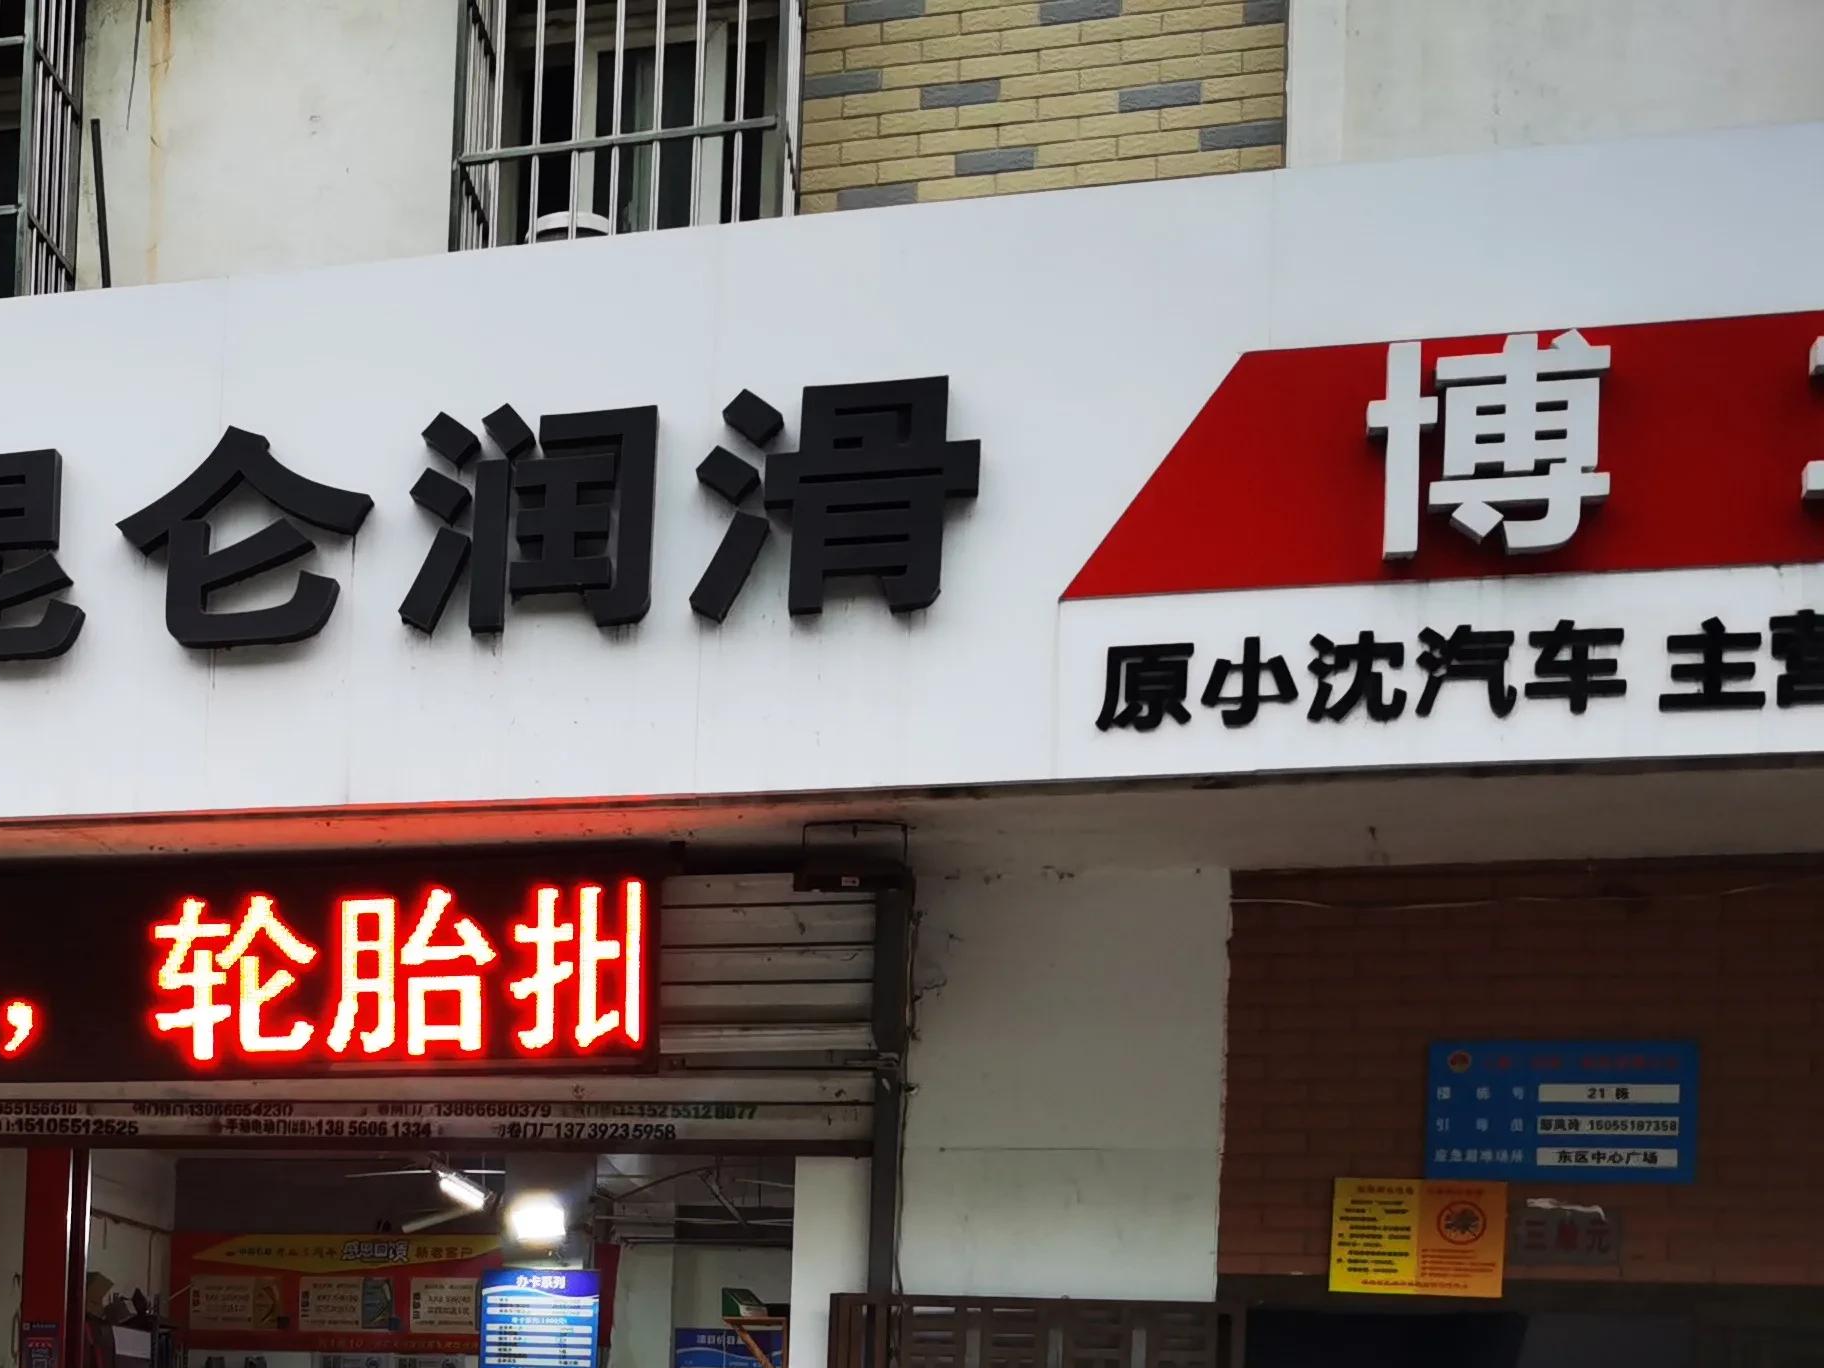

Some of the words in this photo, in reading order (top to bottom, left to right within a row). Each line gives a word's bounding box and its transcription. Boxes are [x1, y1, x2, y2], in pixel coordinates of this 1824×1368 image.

[1095, 617, 1628, 732] 原小沈汽车
[1587, 1087, 1605, 1098] 21
[1557, 1150, 1659, 1166] 东区中心广场
[516, 1275, 566, 1290] 办卡系列
